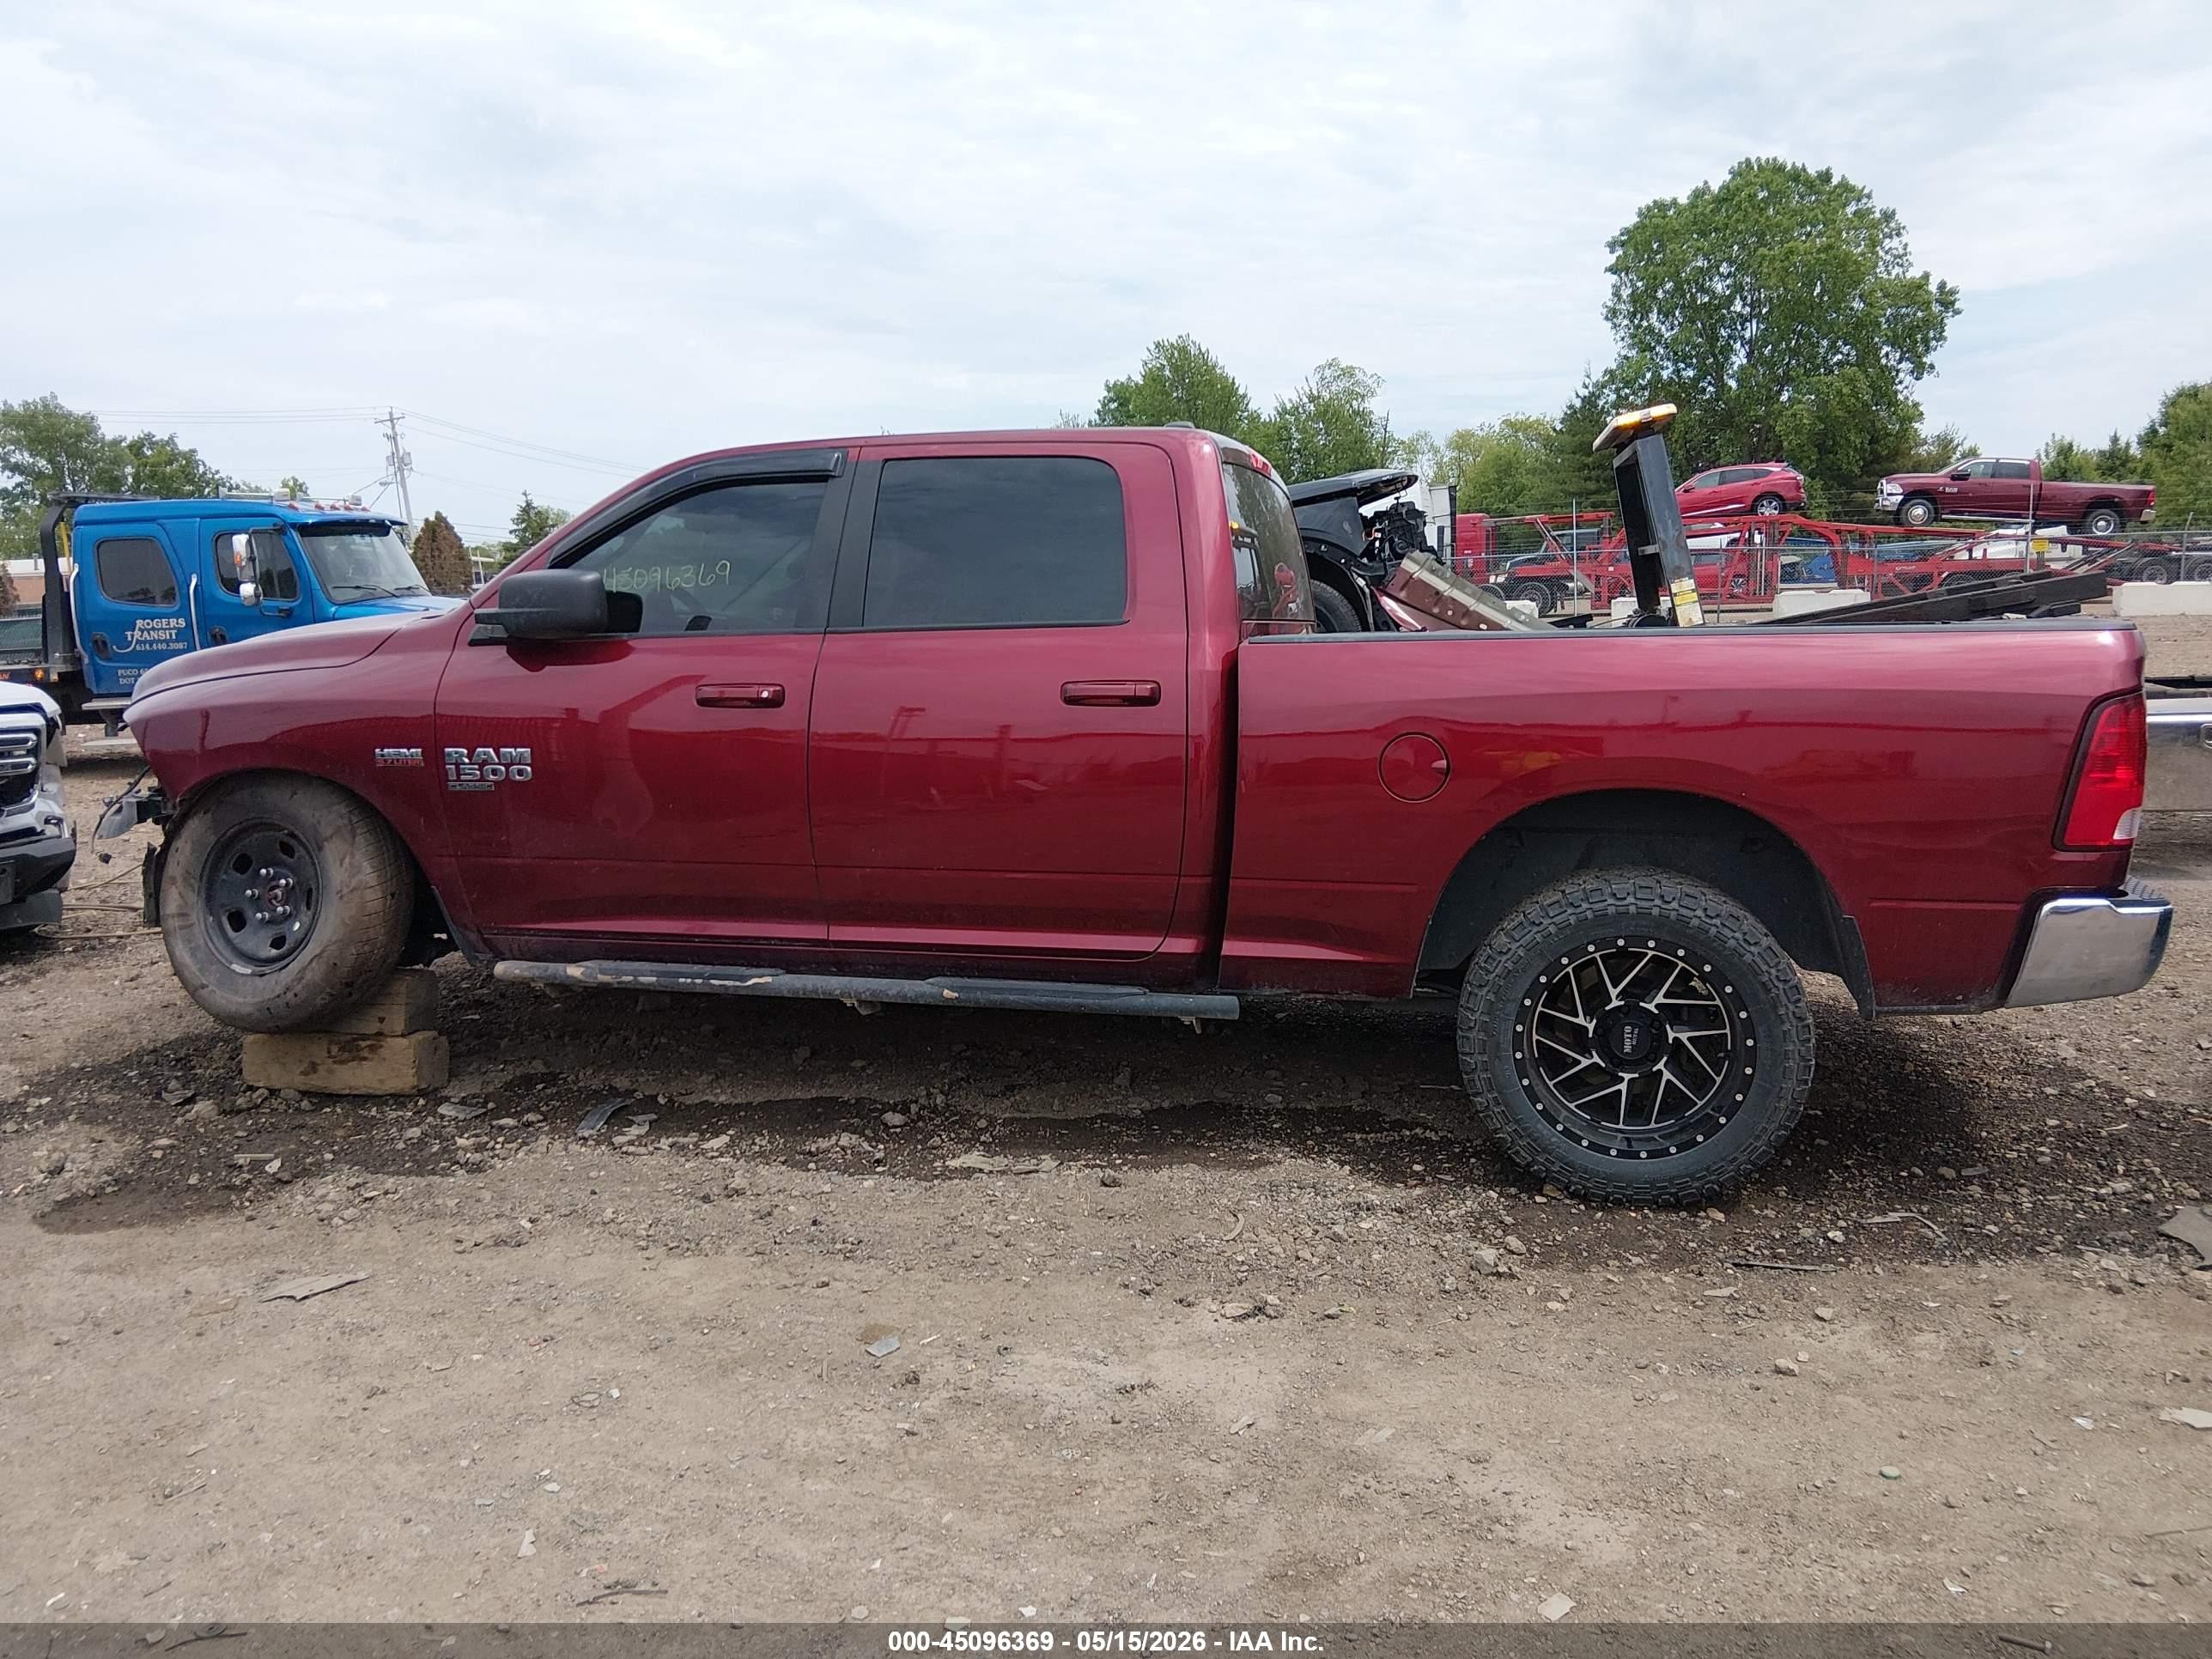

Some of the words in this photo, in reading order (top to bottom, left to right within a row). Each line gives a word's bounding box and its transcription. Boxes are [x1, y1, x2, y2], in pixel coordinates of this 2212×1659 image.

[603, 560, 730, 592] 45096369
[136, 617, 186, 629] ROGERS
[125, 629, 178, 641] TRANSIT
[375, 748, 422, 758] HEMI
[444, 747, 532, 763] RAM
[445, 764, 532, 781] 1500
[1623, 1025, 1632, 1054] MOTO
